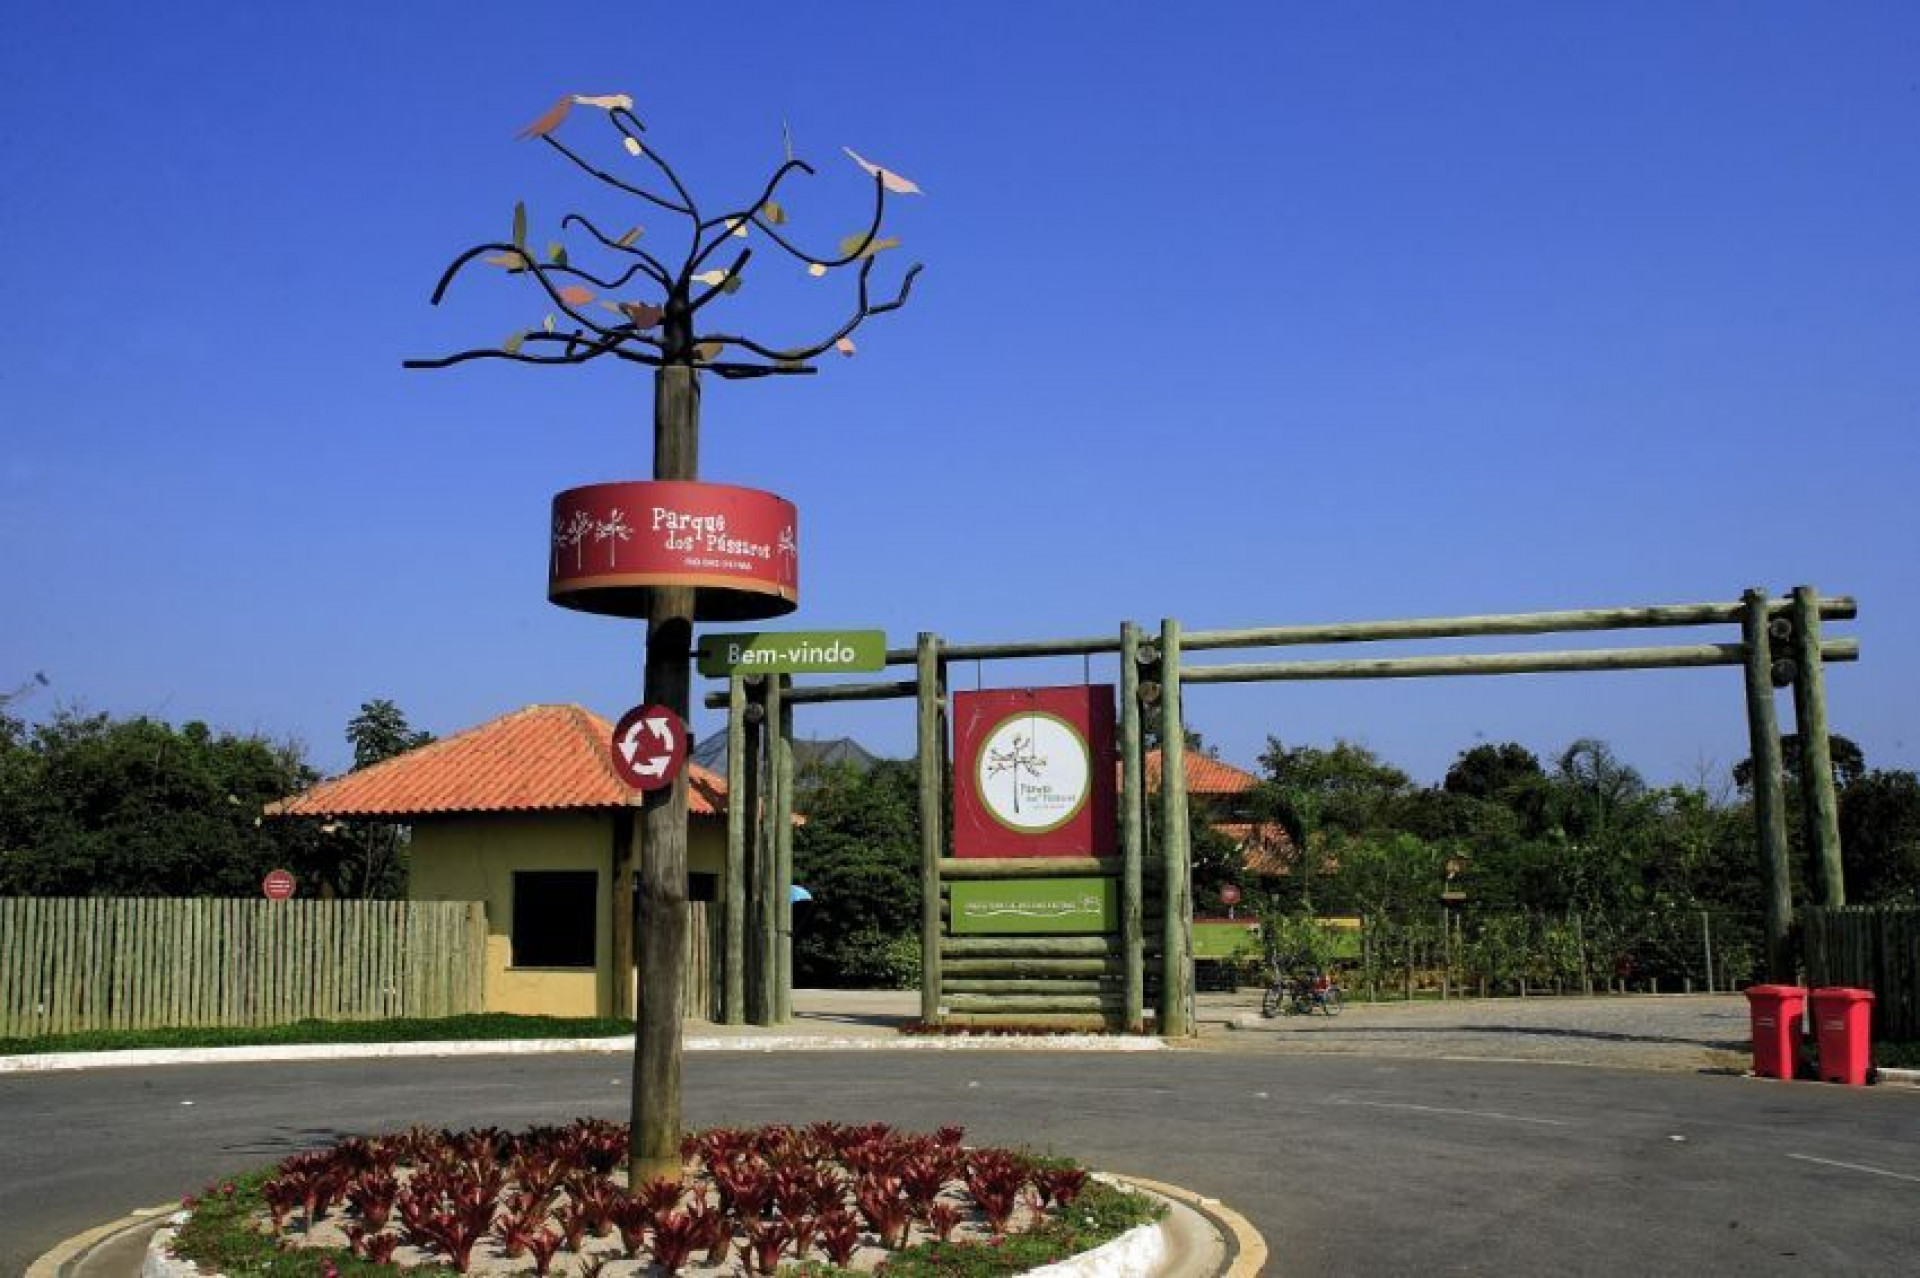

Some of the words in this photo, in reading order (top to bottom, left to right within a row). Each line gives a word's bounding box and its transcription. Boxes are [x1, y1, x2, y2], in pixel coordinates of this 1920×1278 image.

[652, 507, 726, 541] Parque
[665, 530, 694, 551] dos
[727, 640, 855, 664] Bem-vindo
